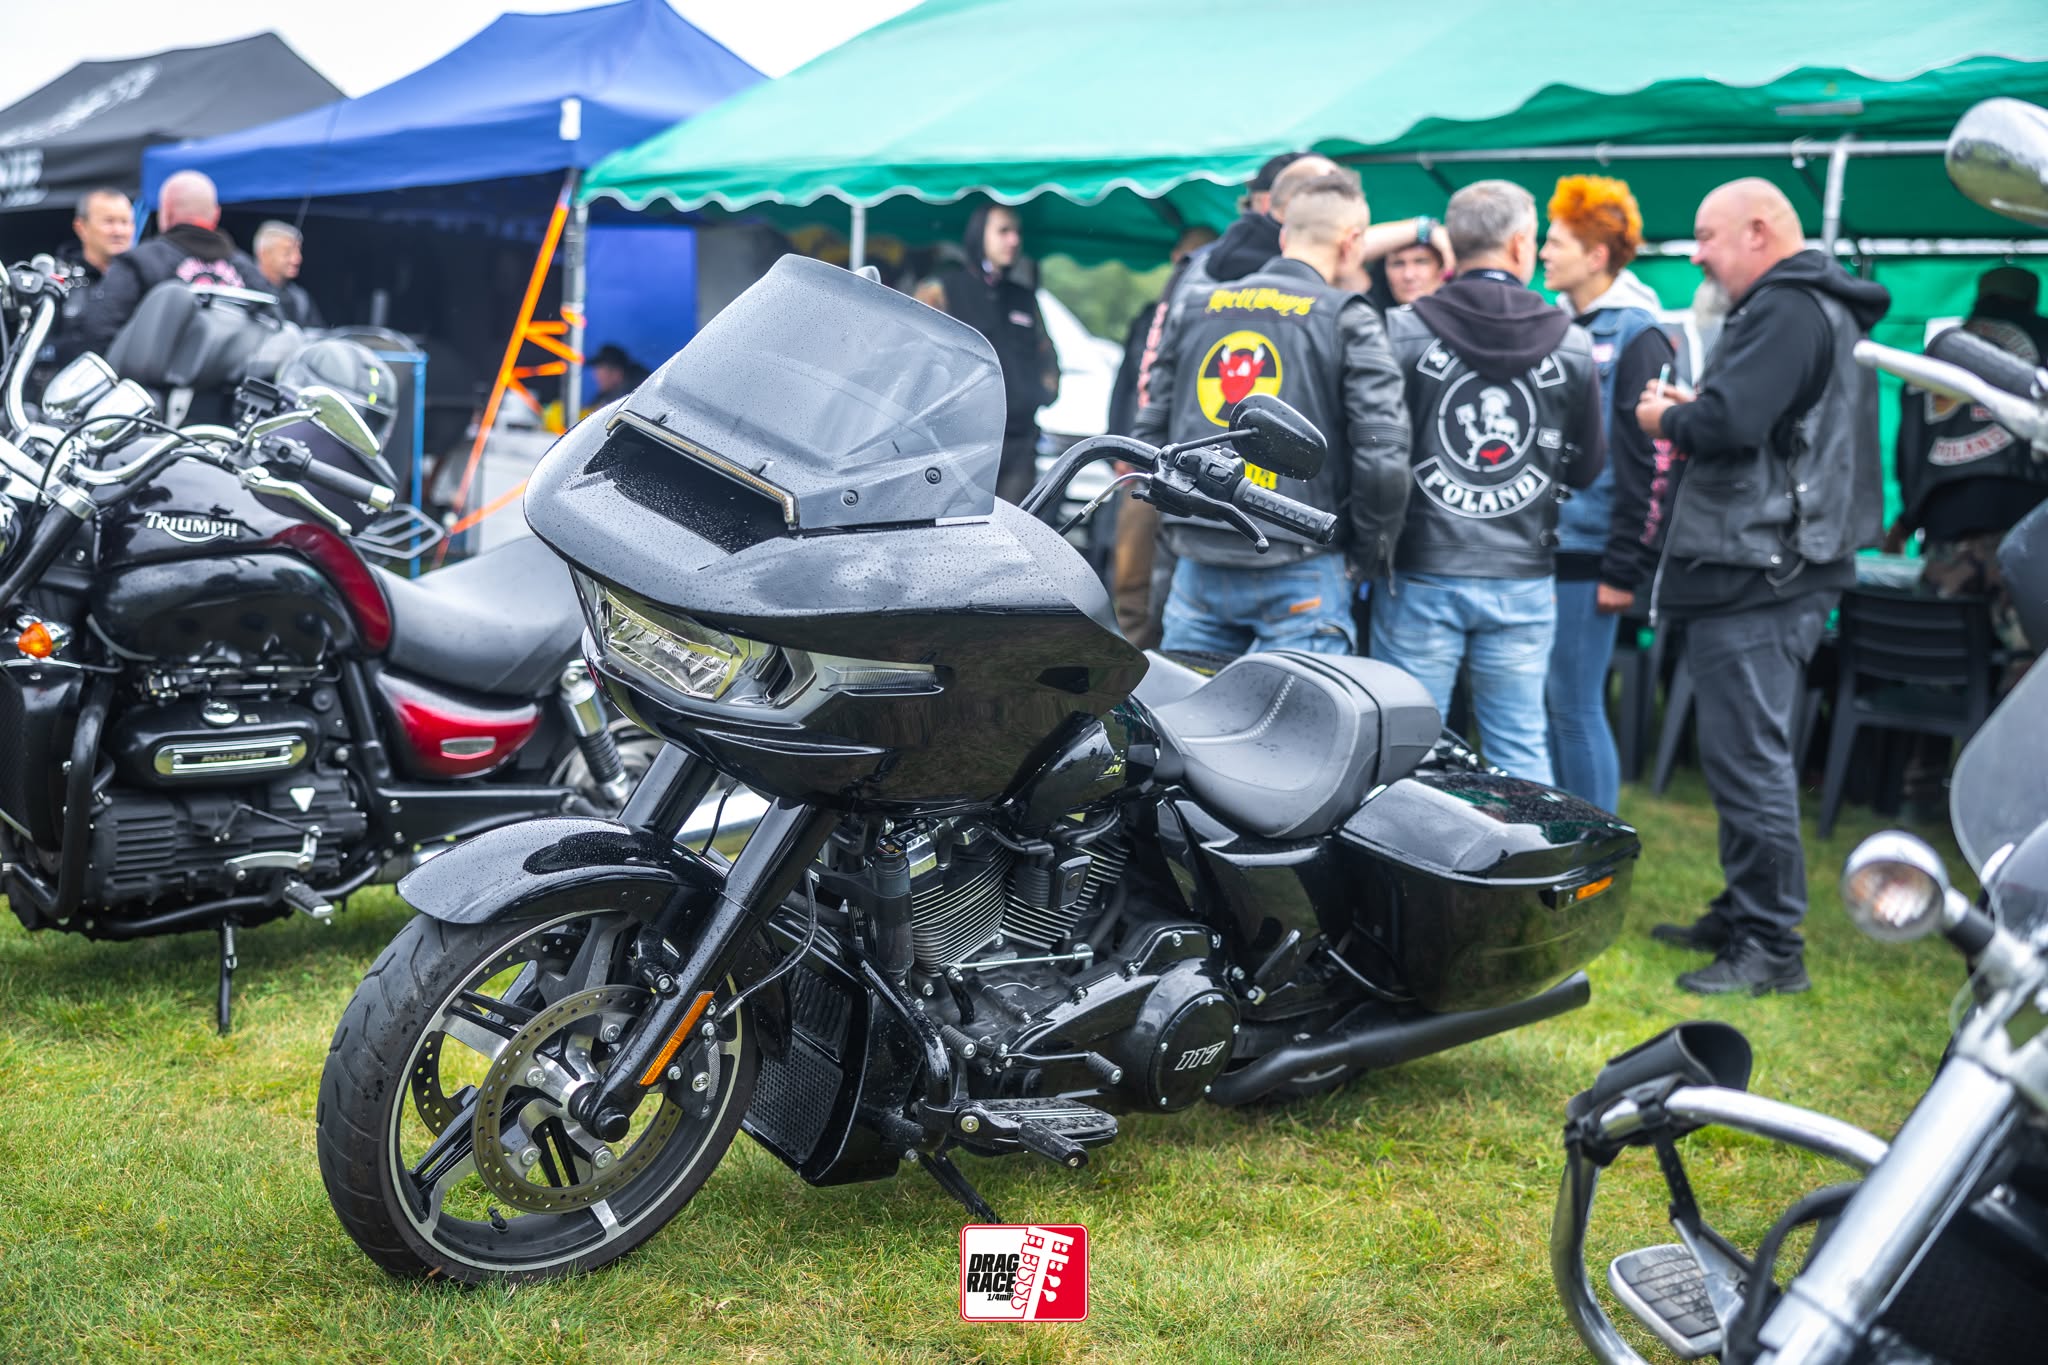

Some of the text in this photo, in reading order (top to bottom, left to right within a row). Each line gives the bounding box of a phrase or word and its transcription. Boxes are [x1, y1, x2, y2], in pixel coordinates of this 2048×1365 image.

[1424, 469, 1537, 513] POLAND
[145, 511, 238, 538] TRIUMPH
[1174, 1040, 1226, 1071] 117
